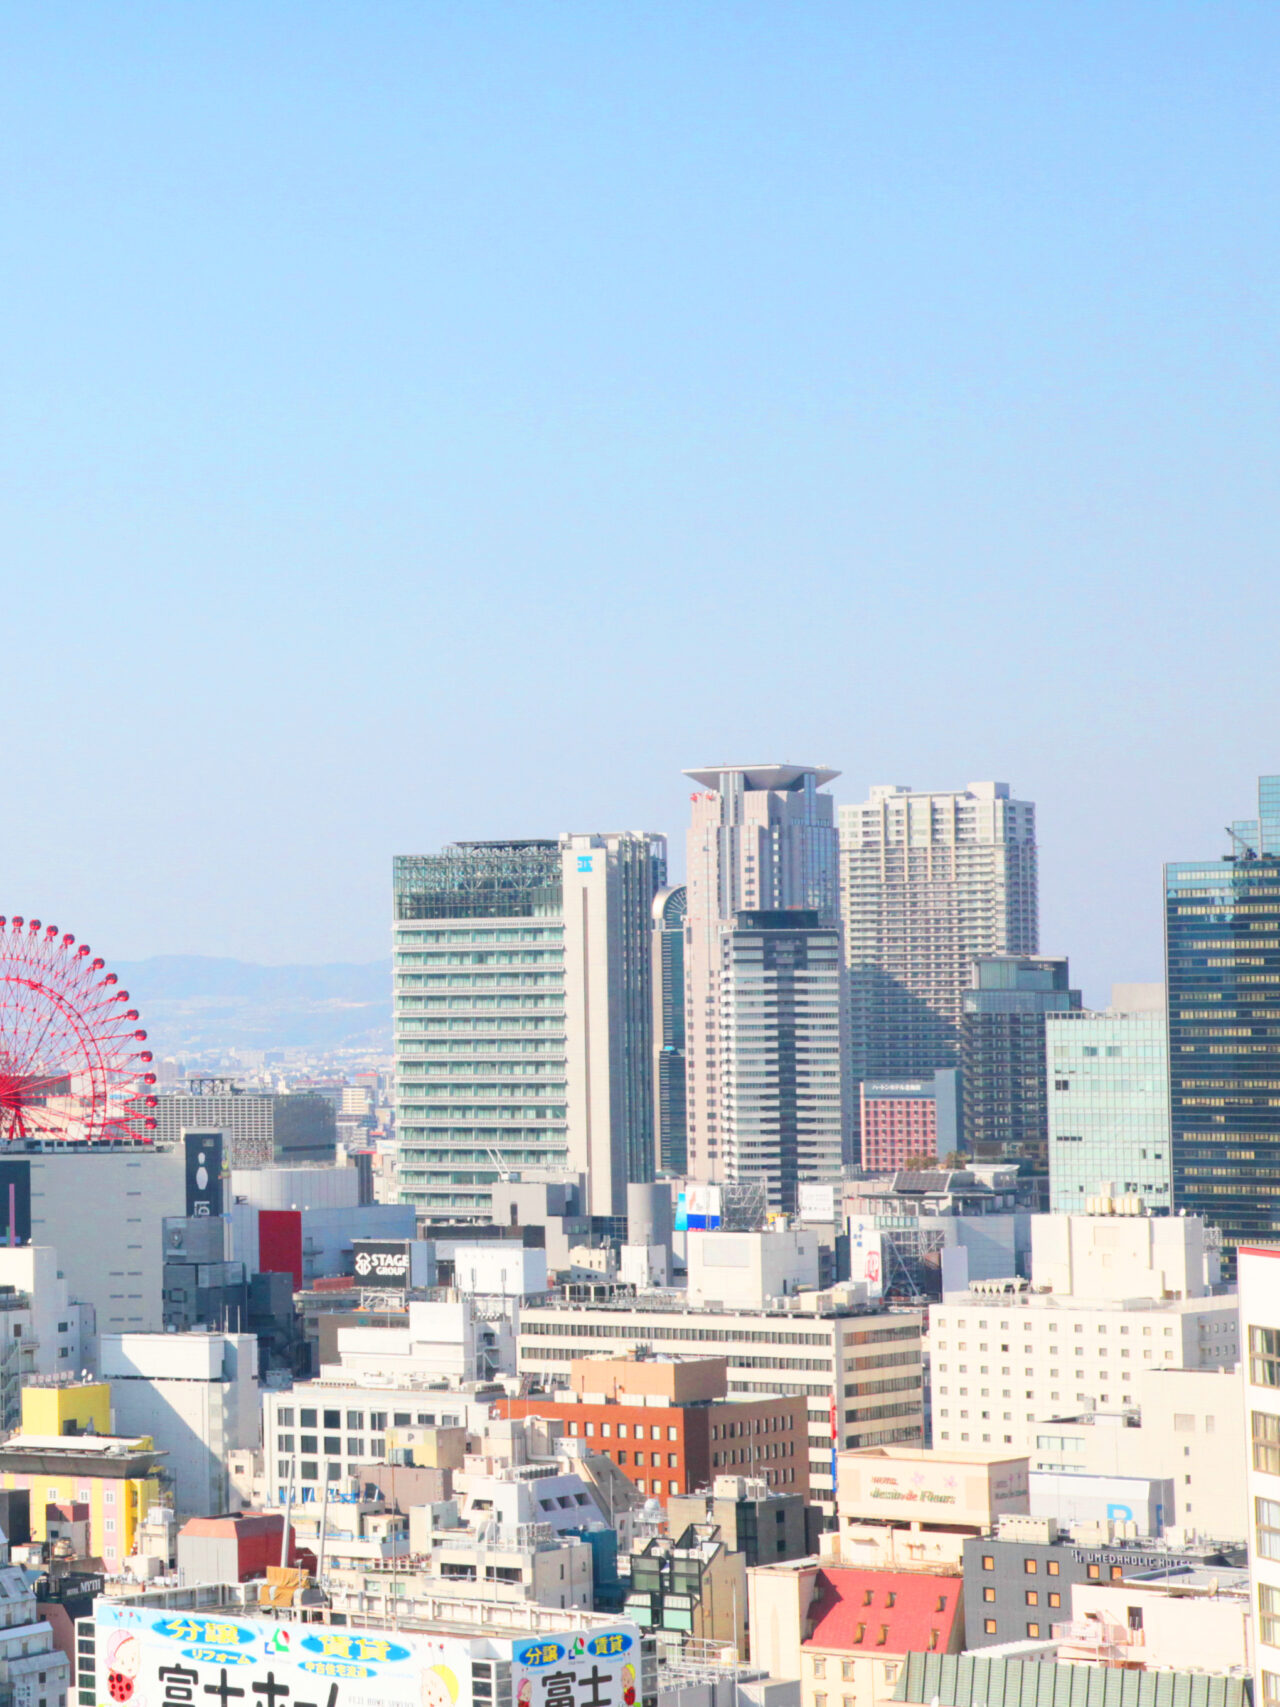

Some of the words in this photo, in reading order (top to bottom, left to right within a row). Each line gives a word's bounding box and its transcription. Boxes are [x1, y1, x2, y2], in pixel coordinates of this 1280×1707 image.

[371, 1253, 410, 1267] STAGE
[375, 1266, 406, 1276] GROUP
[1087, 1552, 1155, 1568] UMEDAHOLIC
[80, 1579, 101, 1593] MYTH
[166, 1619, 239, 1645] 分譲
[319, 1634, 391, 1662] 賃貸
[595, 1635, 623, 1656] 賃貸
[192, 1649, 251, 1664] リフォーム
[525, 1645, 558, 1665] 分譲
